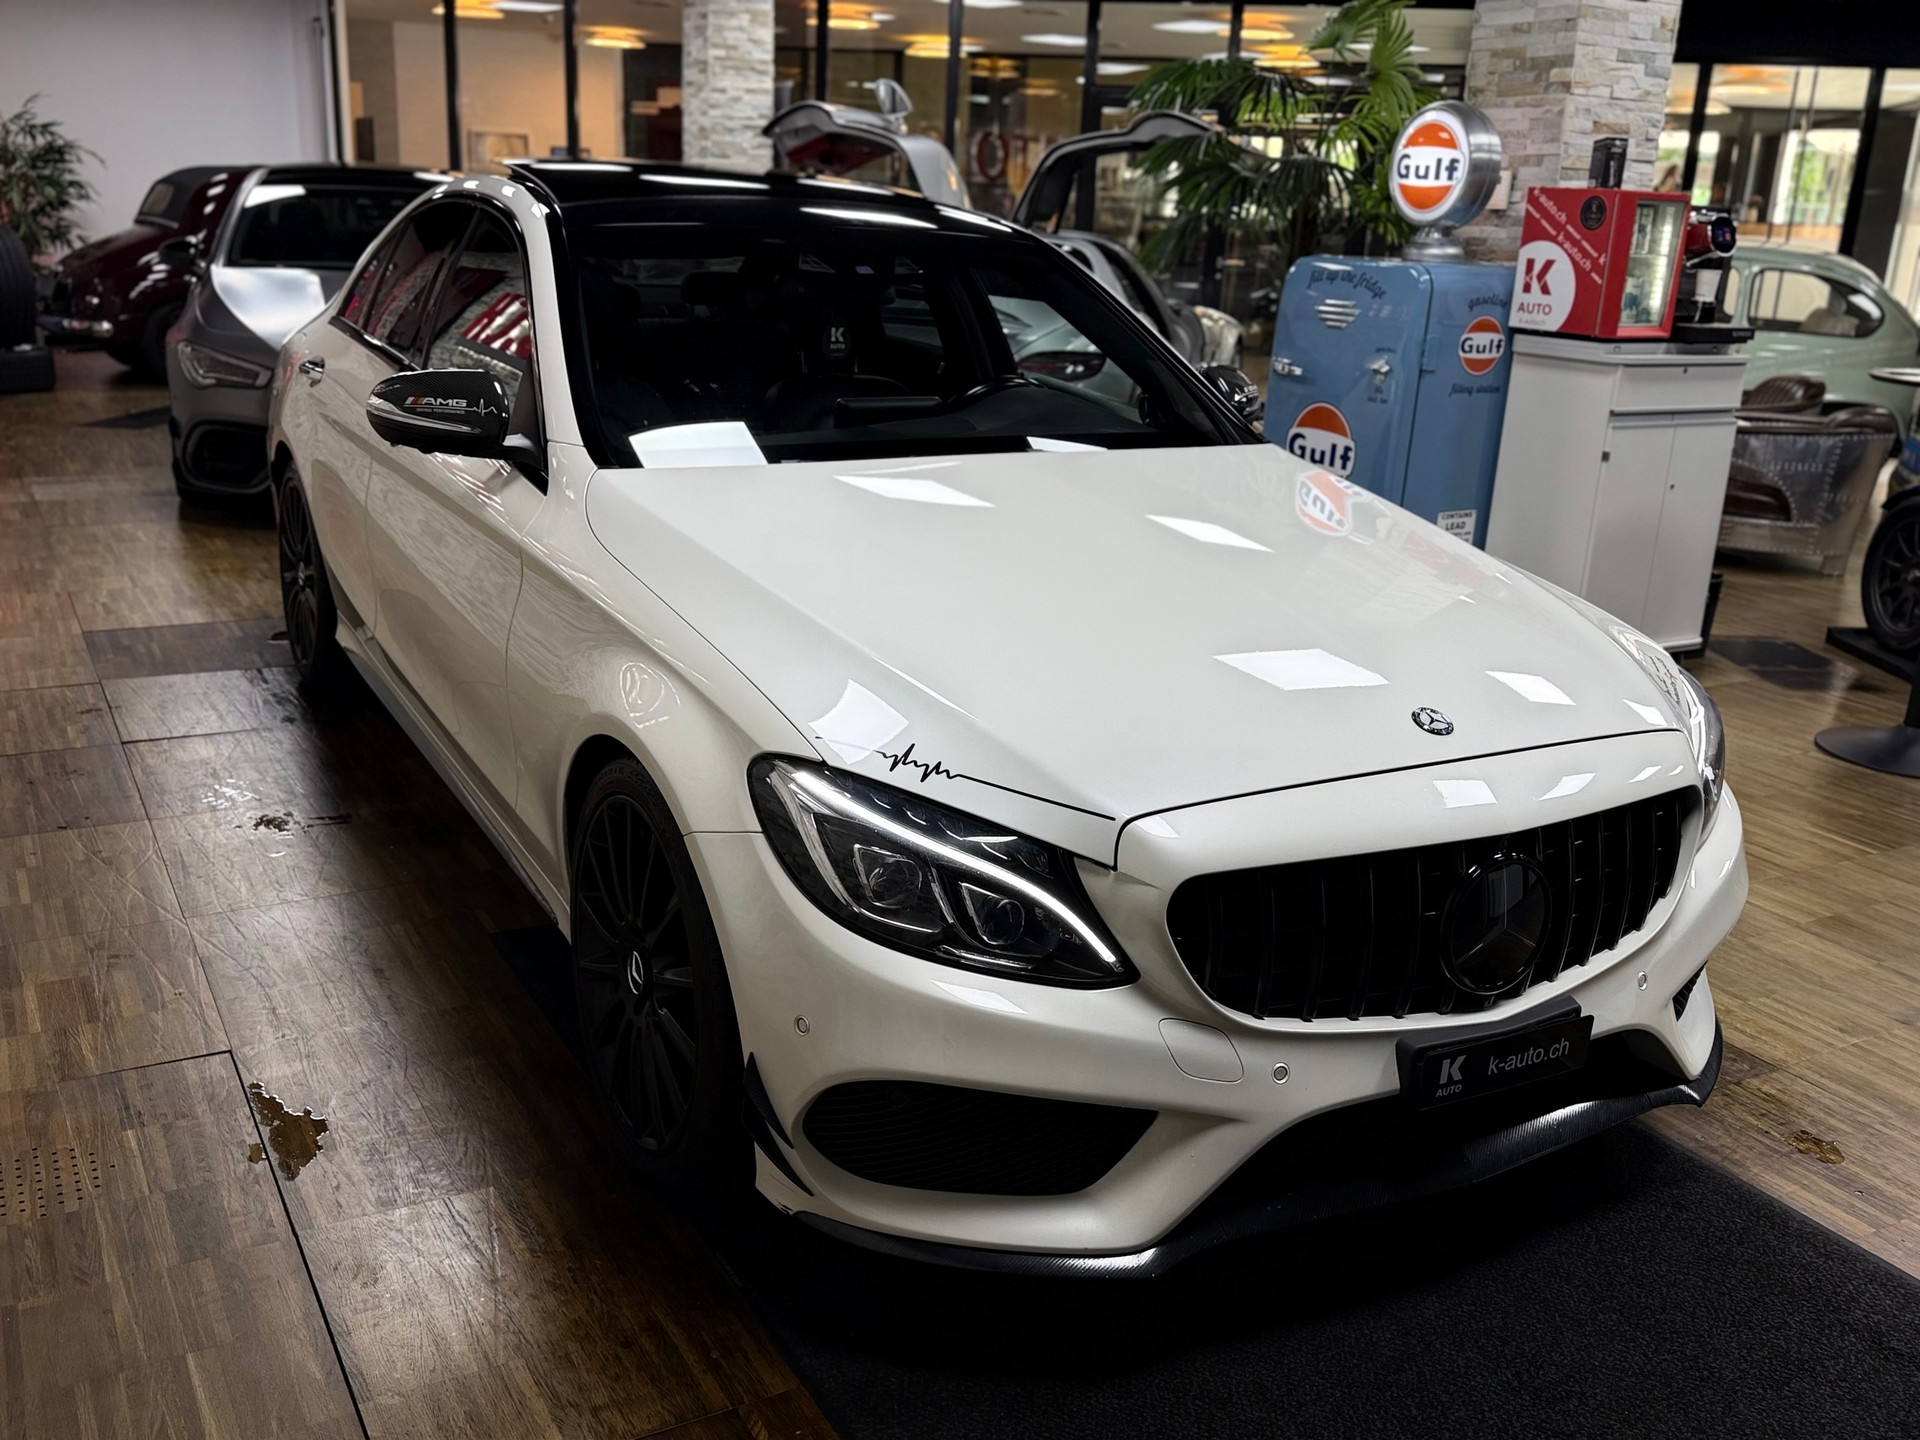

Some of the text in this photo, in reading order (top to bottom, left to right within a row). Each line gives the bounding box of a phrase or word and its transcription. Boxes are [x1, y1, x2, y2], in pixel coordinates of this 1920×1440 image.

[1397, 154, 1460, 181] Gulf
[1557, 231, 1592, 271] k-auto.ch
[1353, 271, 1387, 300] fridge
[1522, 257, 1557, 296] K
[1517, 302, 1552, 316] AUTO
[831, 327, 845, 342] K
[1461, 336, 1503, 354] Gulf
[1288, 431, 1353, 471] Gulf
[1441, 511, 1472, 520] CONTAINS
[1445, 521, 1466, 531] LEAD
[1439, 1054, 1467, 1085] K
[1487, 1037, 1570, 1076] k-auto.ch
[1435, 1084, 1463, 1098] AUTO
